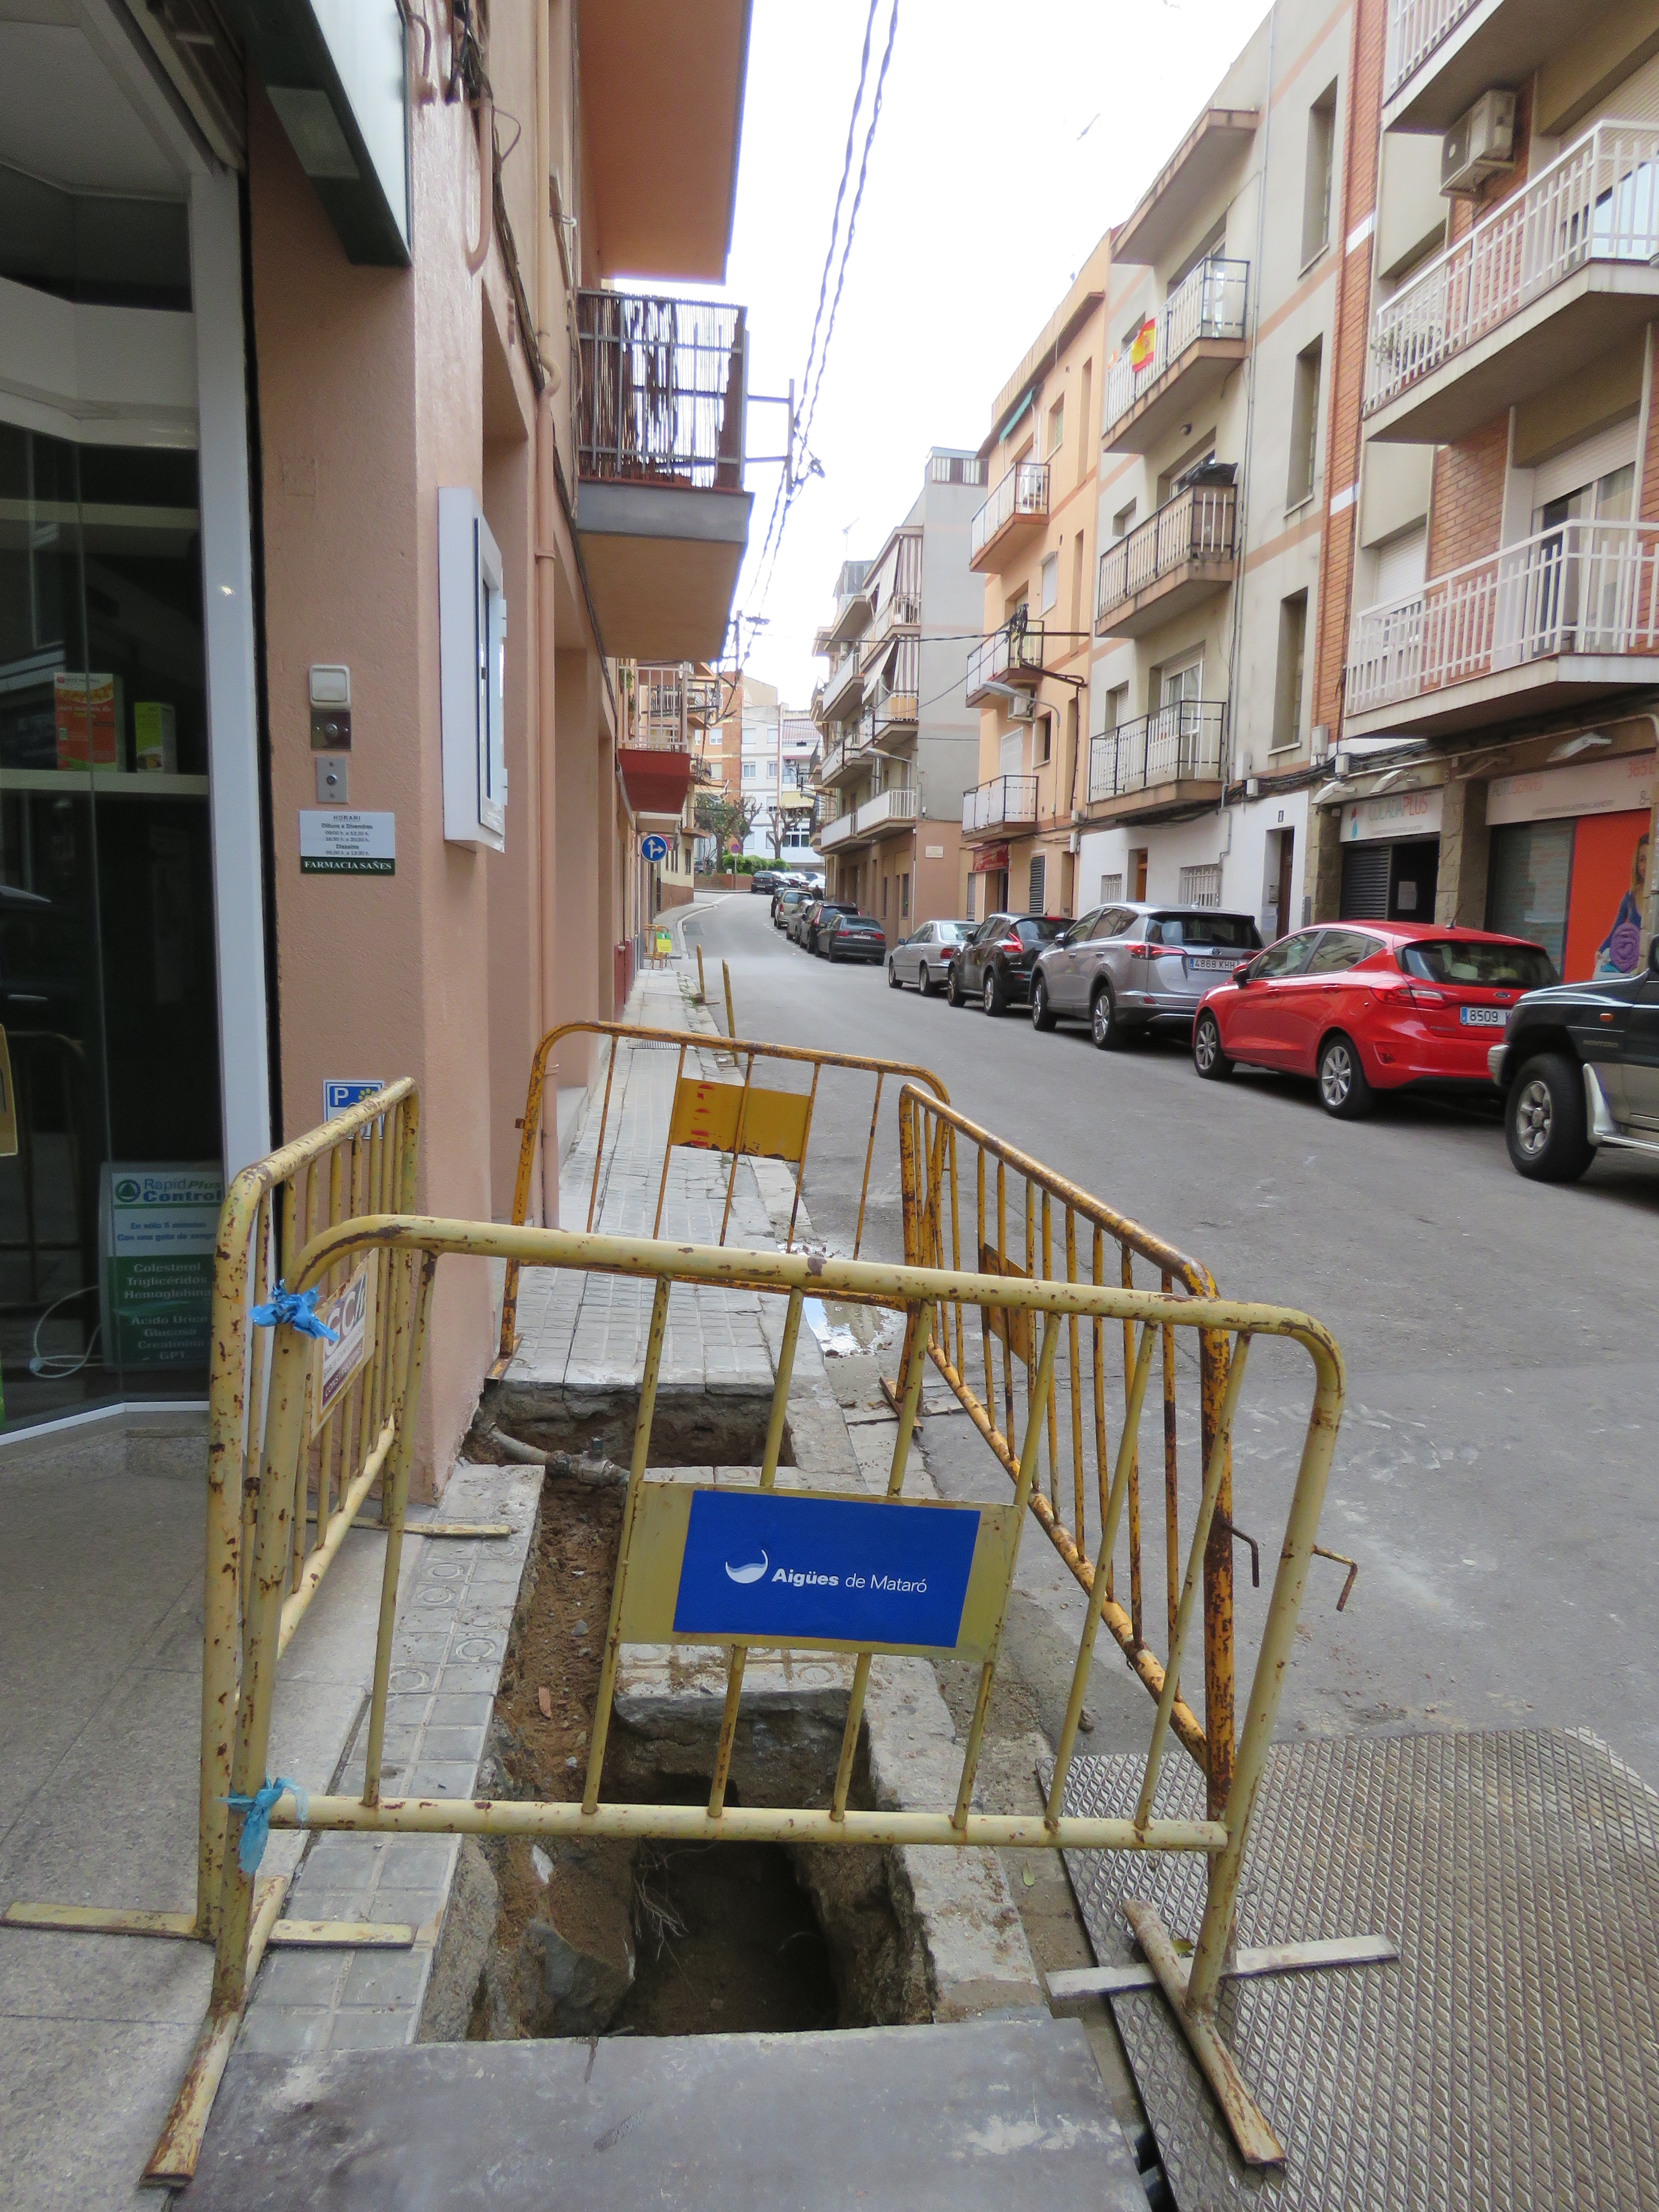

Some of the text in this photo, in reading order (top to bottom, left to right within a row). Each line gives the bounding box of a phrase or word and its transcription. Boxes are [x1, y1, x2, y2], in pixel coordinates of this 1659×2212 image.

[304, 861, 392, 870] FARMACIA SAÑES
[1195, 960, 1235, 969] 4868 KHH
[1469, 1010, 1498, 1022] 8509
[1583, 1039, 1619, 1048] MONTERO
[334, 1087, 349, 1106] P
[144, 1178, 222, 1191] Rapid Plus
[144, 1190, 222, 1202] Control
[155, 1234, 175, 1242] gota
[134, 1262, 201, 1273] Colesterol
[127, 1275, 207, 1287] Triglicéridos
[124, 1289, 212, 1299] Hemoglobina
[144, 1328, 197, 1337] Glucosa
[137, 1339, 204, 1349] Creatinina
[159, 1351, 186, 1360] GPT
[771, 1567, 927, 1593] Aigües de Mataró
